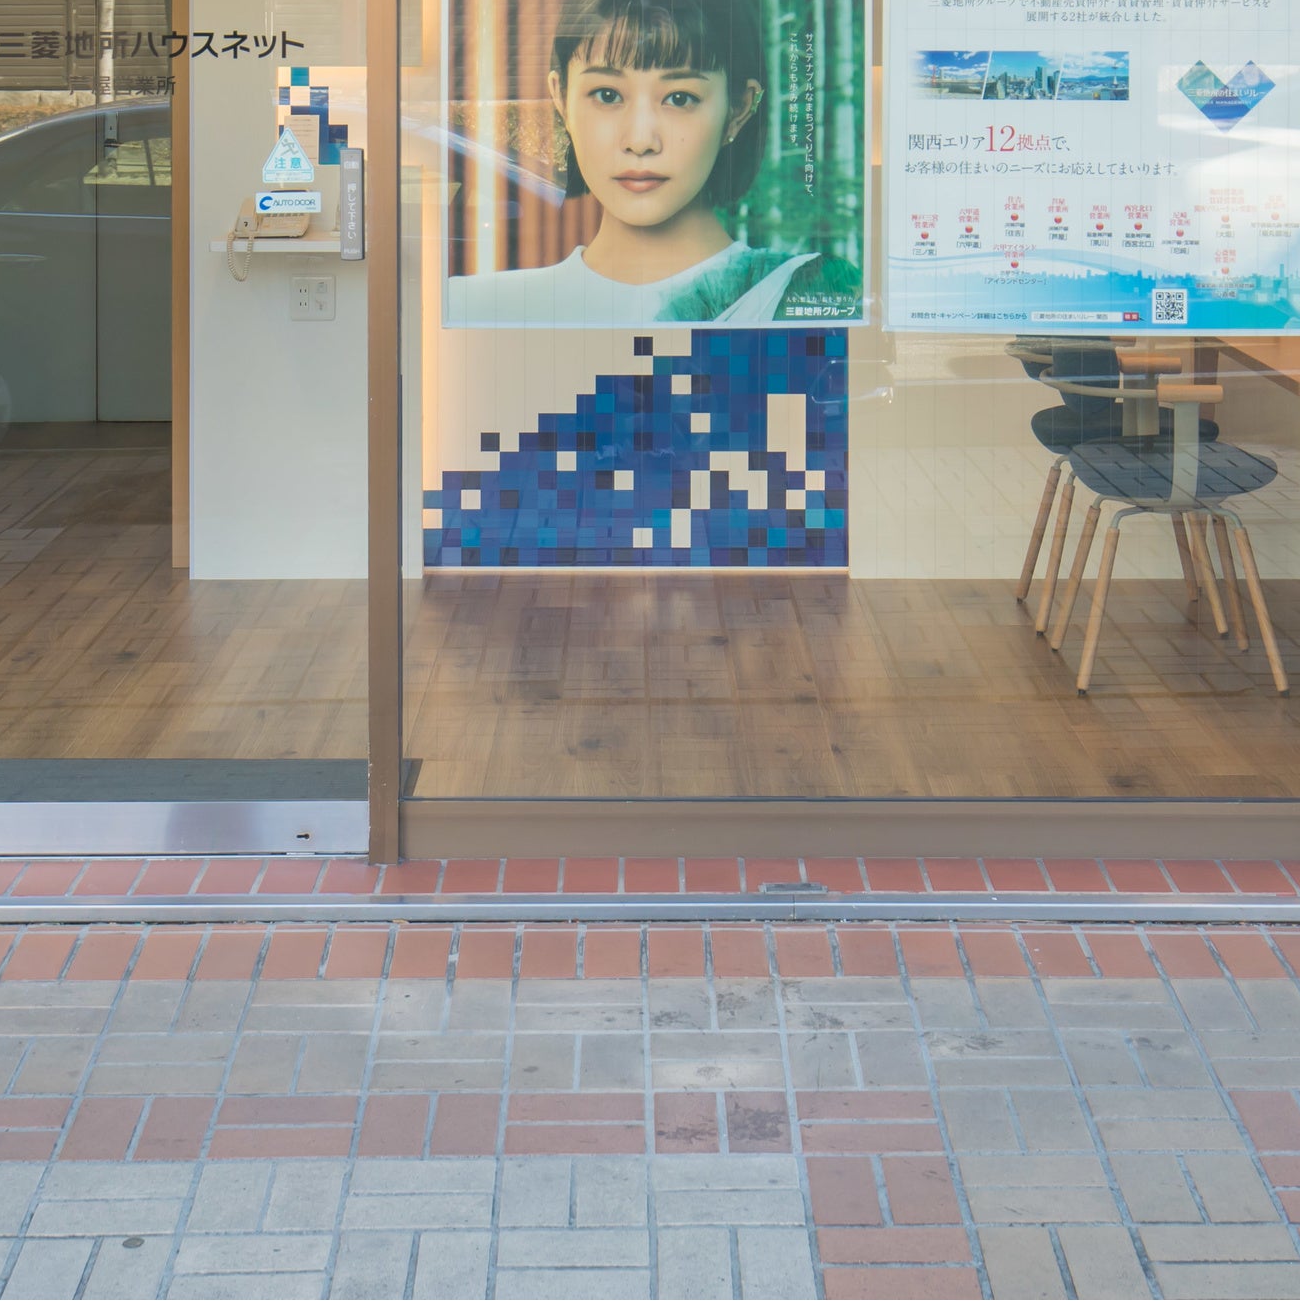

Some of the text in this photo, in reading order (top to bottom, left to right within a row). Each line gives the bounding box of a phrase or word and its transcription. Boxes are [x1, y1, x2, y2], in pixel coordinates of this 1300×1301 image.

[908, 125, 1073, 152] 関西エリア12拠点で、
[786, 306, 856, 316] 三菱地所グループ
